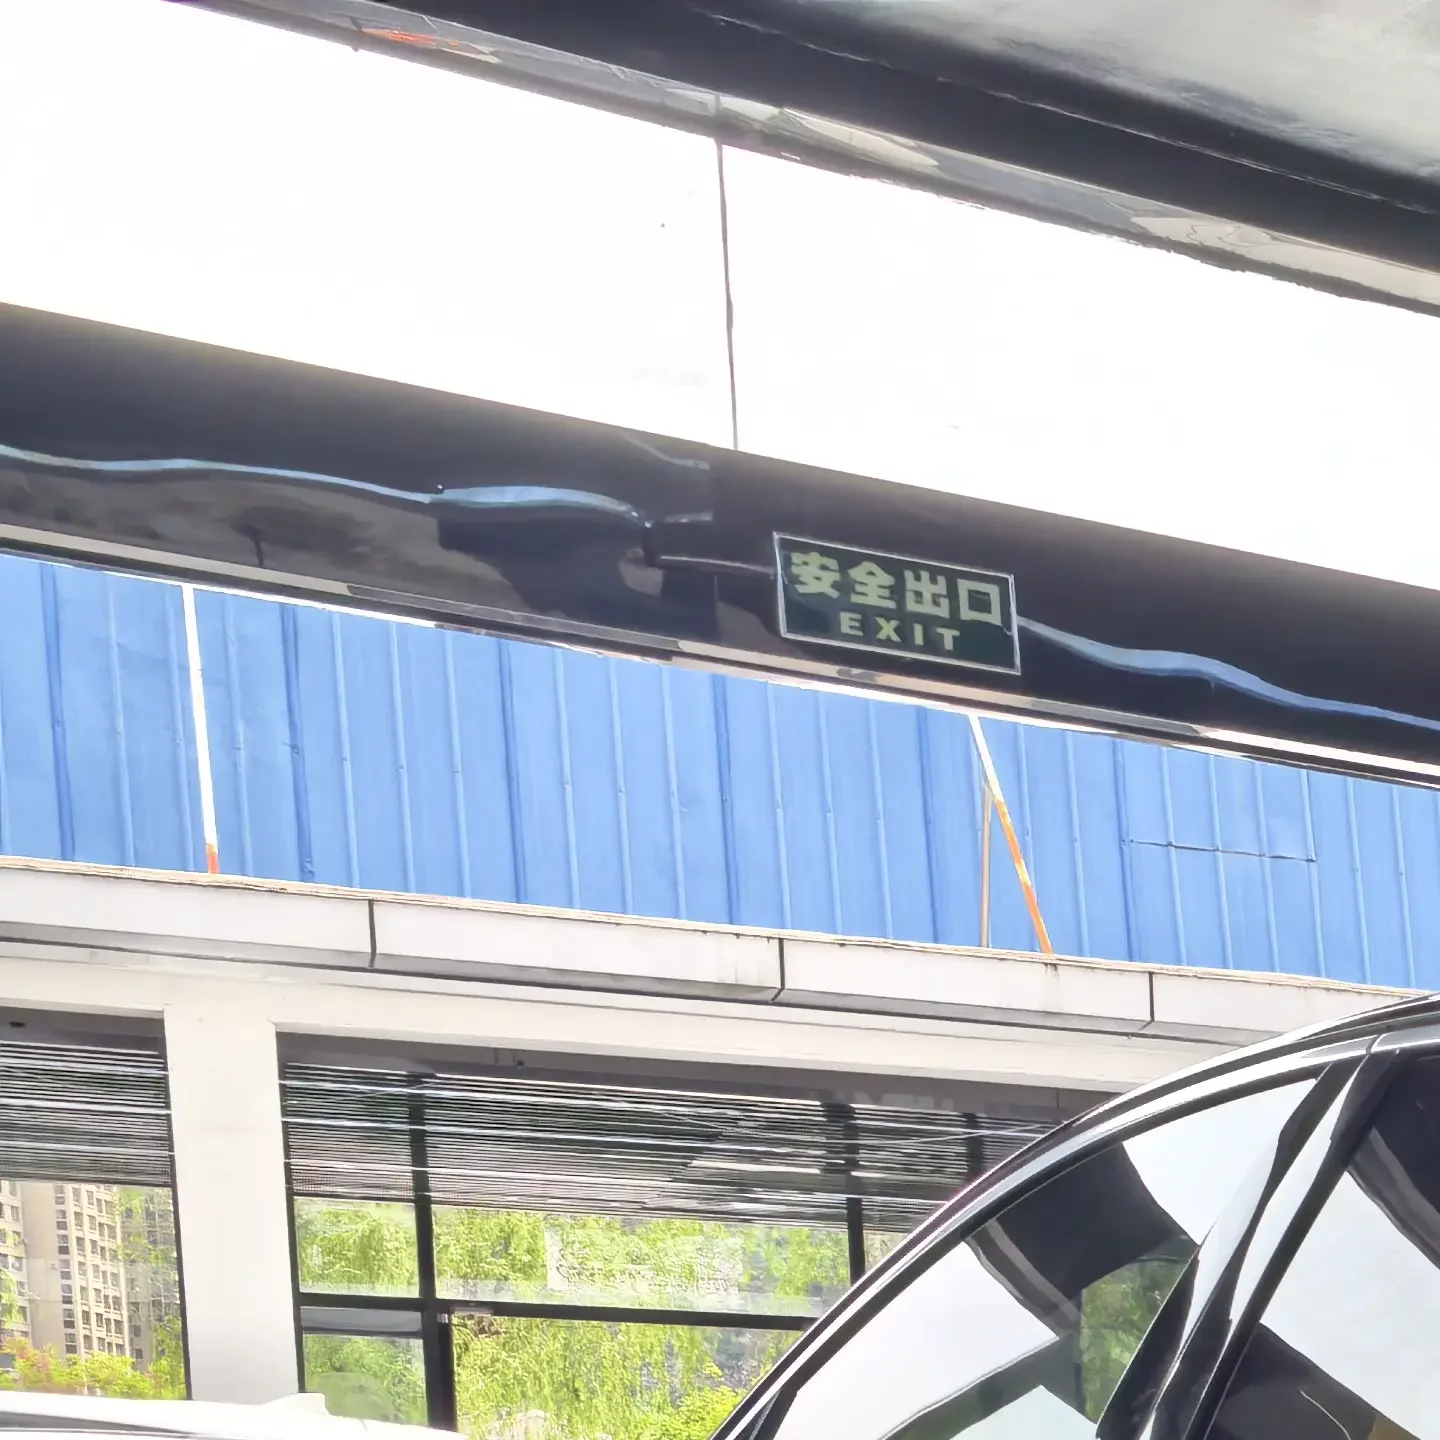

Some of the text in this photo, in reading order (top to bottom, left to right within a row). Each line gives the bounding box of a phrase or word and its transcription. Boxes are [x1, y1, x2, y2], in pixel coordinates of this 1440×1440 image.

[790, 551, 1004, 627] 安全出口
[839, 610, 961, 651] EXIT
